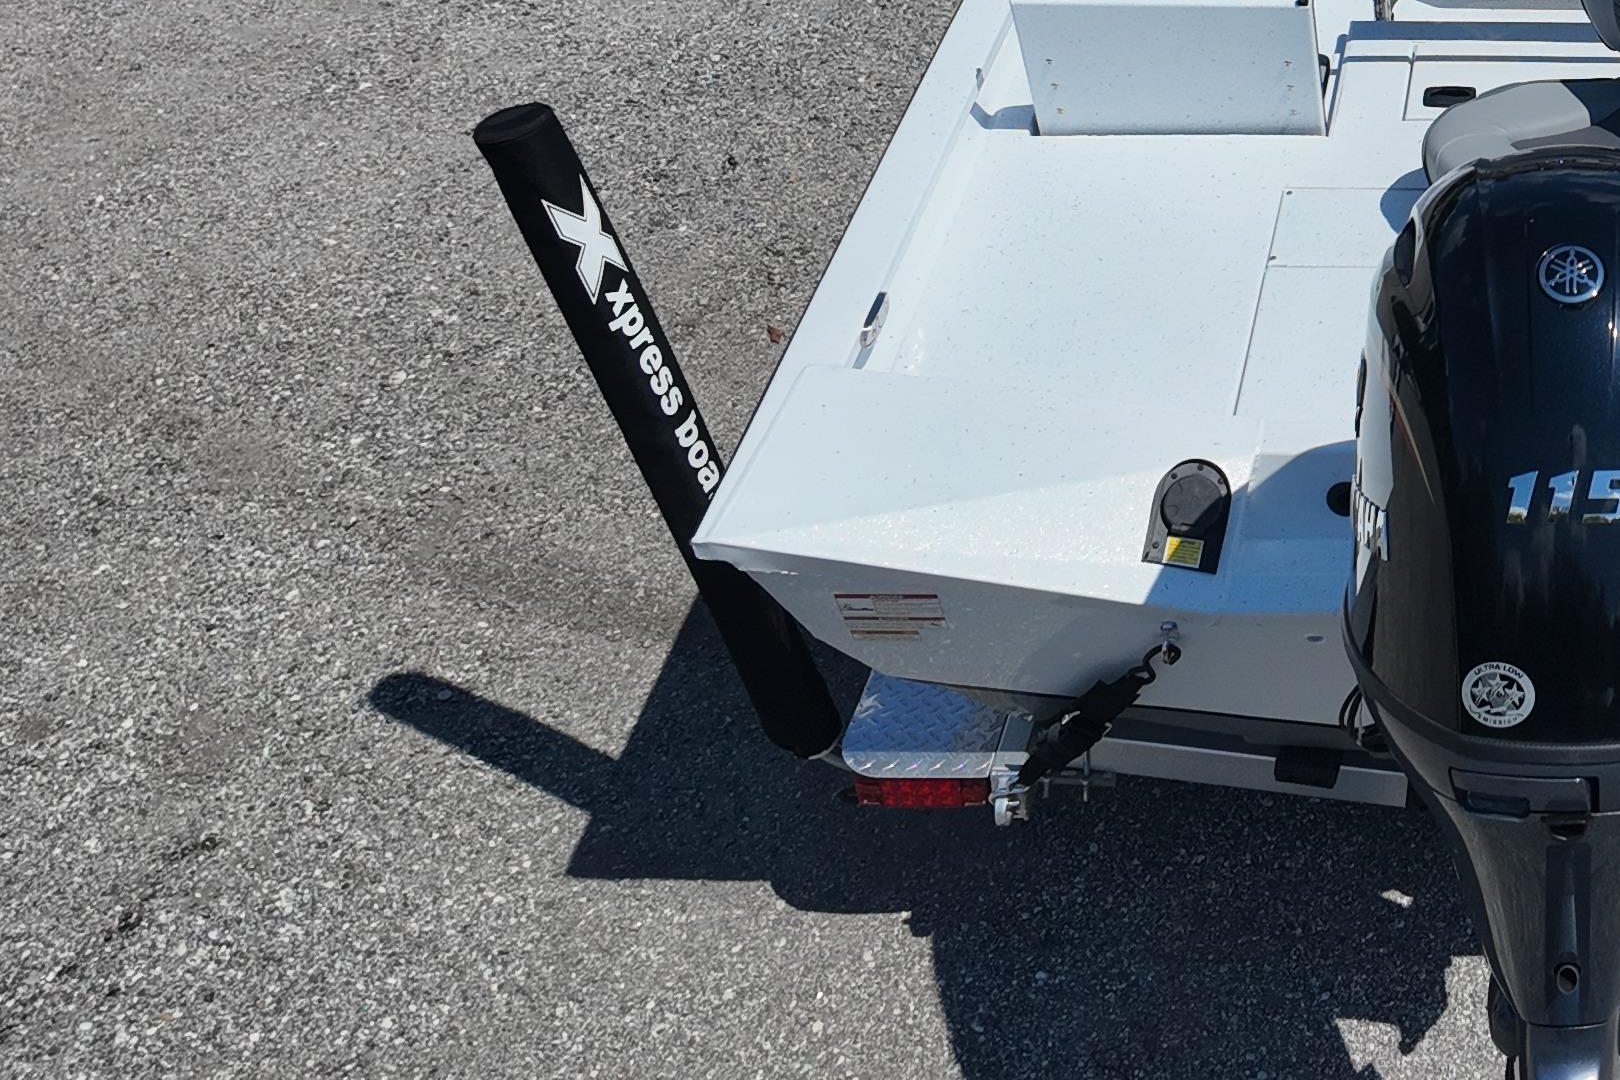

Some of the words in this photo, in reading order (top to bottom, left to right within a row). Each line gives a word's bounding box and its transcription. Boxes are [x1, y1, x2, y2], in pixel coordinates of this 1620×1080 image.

[604, 278, 683, 416] xpress
[674, 409, 720, 500] boa
[1474, 663, 1501, 676] ULTRA
[1503, 665, 1524, 679] LOW
